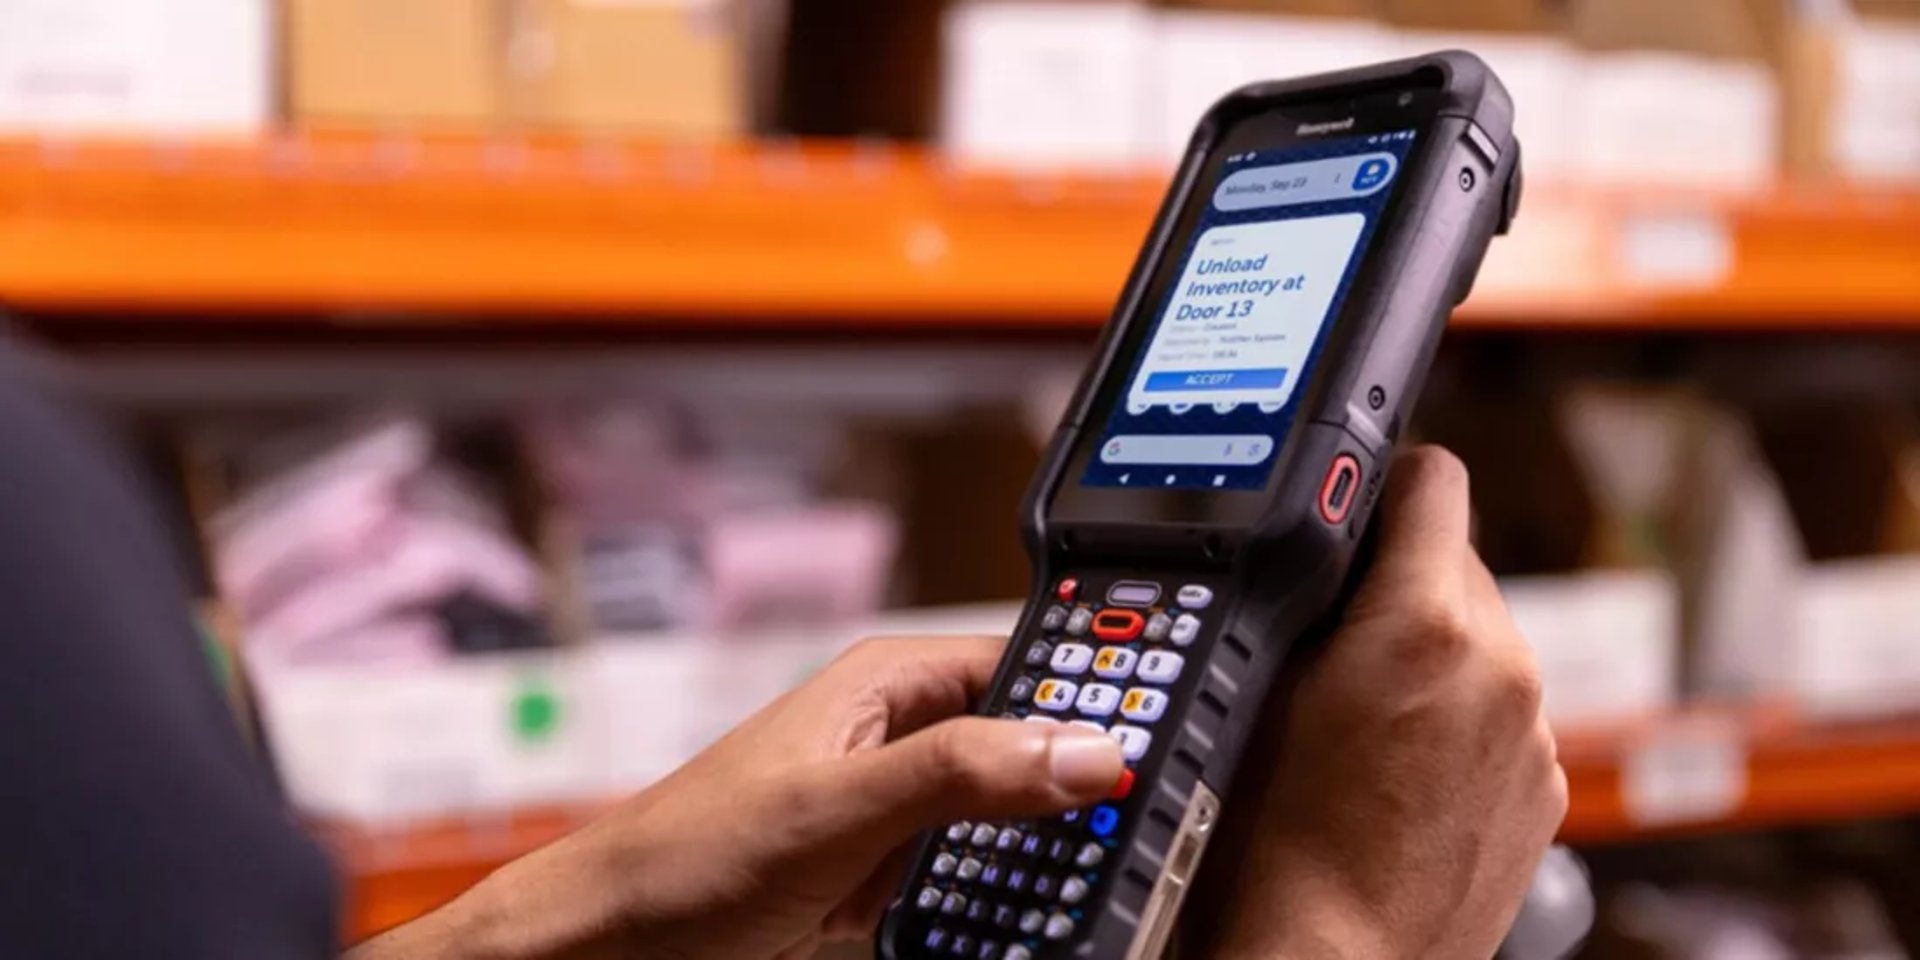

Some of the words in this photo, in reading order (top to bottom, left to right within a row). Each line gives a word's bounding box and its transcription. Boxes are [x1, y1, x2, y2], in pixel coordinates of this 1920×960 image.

[1197, 253, 1269, 275] Unload
[1187, 279, 1282, 297] Inventory
[1282, 274, 1305, 291] at
[1176, 303, 1224, 321] Door
[1226, 300, 1255, 318] 13
[1184, 373, 1235, 385] ACCEPT
[1061, 649, 1074, 663] 7
[1114, 652, 1128, 669] 8
[1148, 656, 1161, 671] 9
[1054, 687, 1066, 702] 4
[1088, 687, 1102, 703] 5
[1142, 695, 1156, 711] 6
[1023, 836, 1039, 853] H
[981, 865, 998, 884] M
[1007, 870, 1024, 889] N
